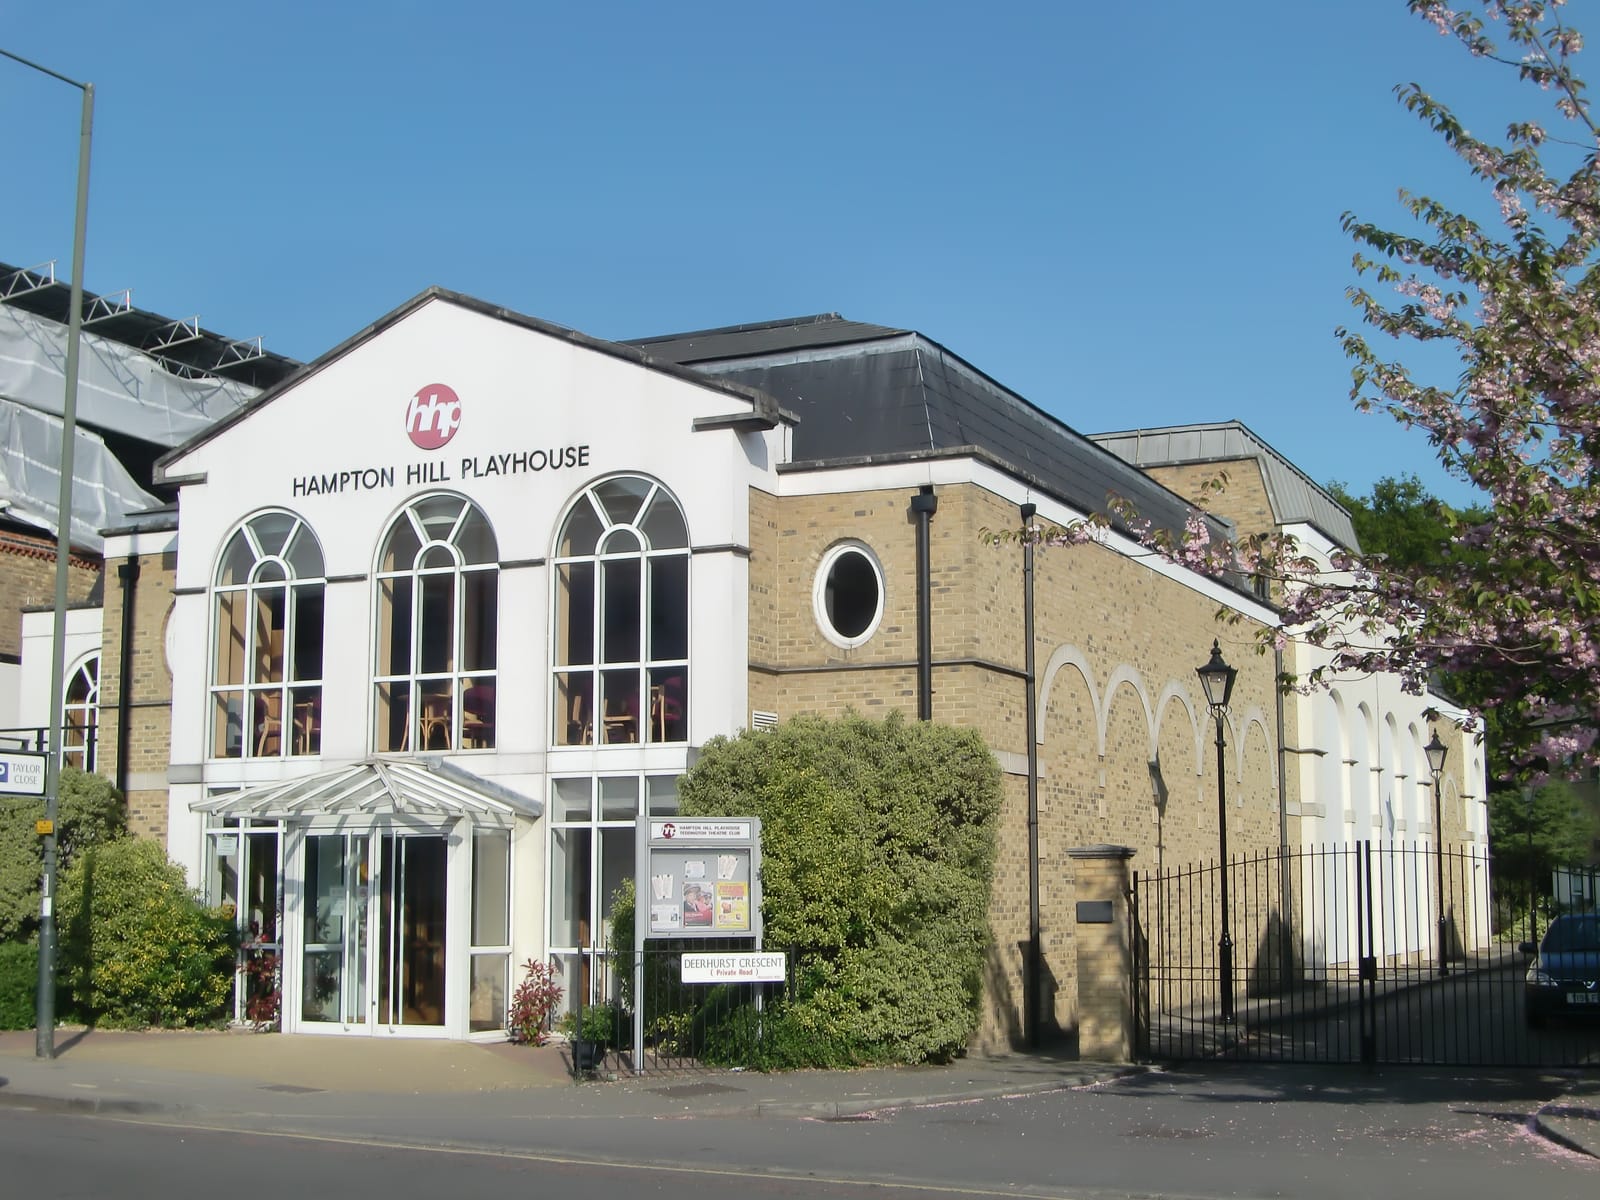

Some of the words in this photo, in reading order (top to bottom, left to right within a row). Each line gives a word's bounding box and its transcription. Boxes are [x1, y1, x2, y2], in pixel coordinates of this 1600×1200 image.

[293, 466, 394, 497] HAMPTON
[406, 461, 450, 485] HILL
[461, 445, 590, 479] PLAYHOUSE
[12, 763, 40, 774] TAYLOR
[14, 774, 38, 785] CLOSE
[684, 958, 736, 969] DEERHURST
[739, 957, 783, 968] CRESCENT
